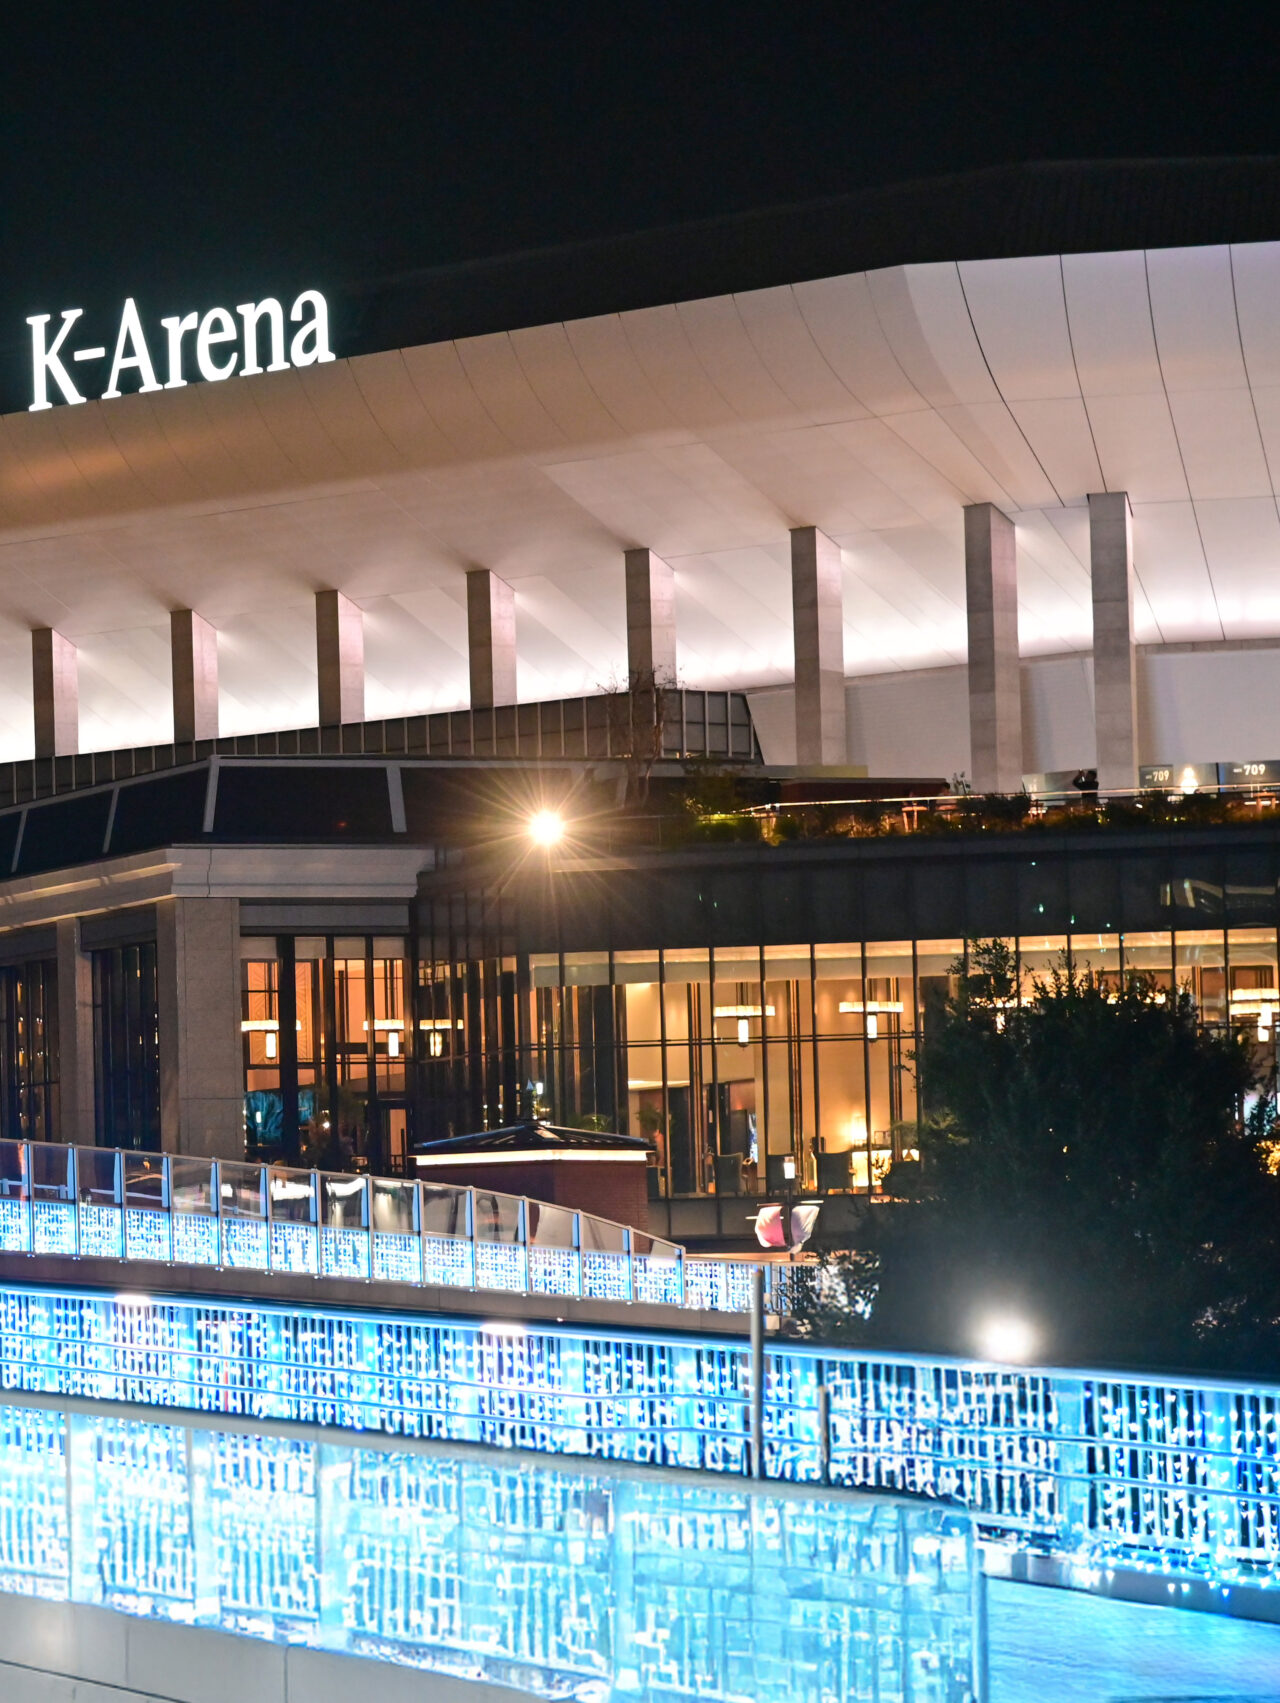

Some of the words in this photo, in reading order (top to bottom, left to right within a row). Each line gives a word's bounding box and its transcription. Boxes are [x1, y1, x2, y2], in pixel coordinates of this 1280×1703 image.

[26, 290, 336, 412] K-Arena
[1152, 769, 1170, 782] 709
[1243, 764, 1266, 776] 709
